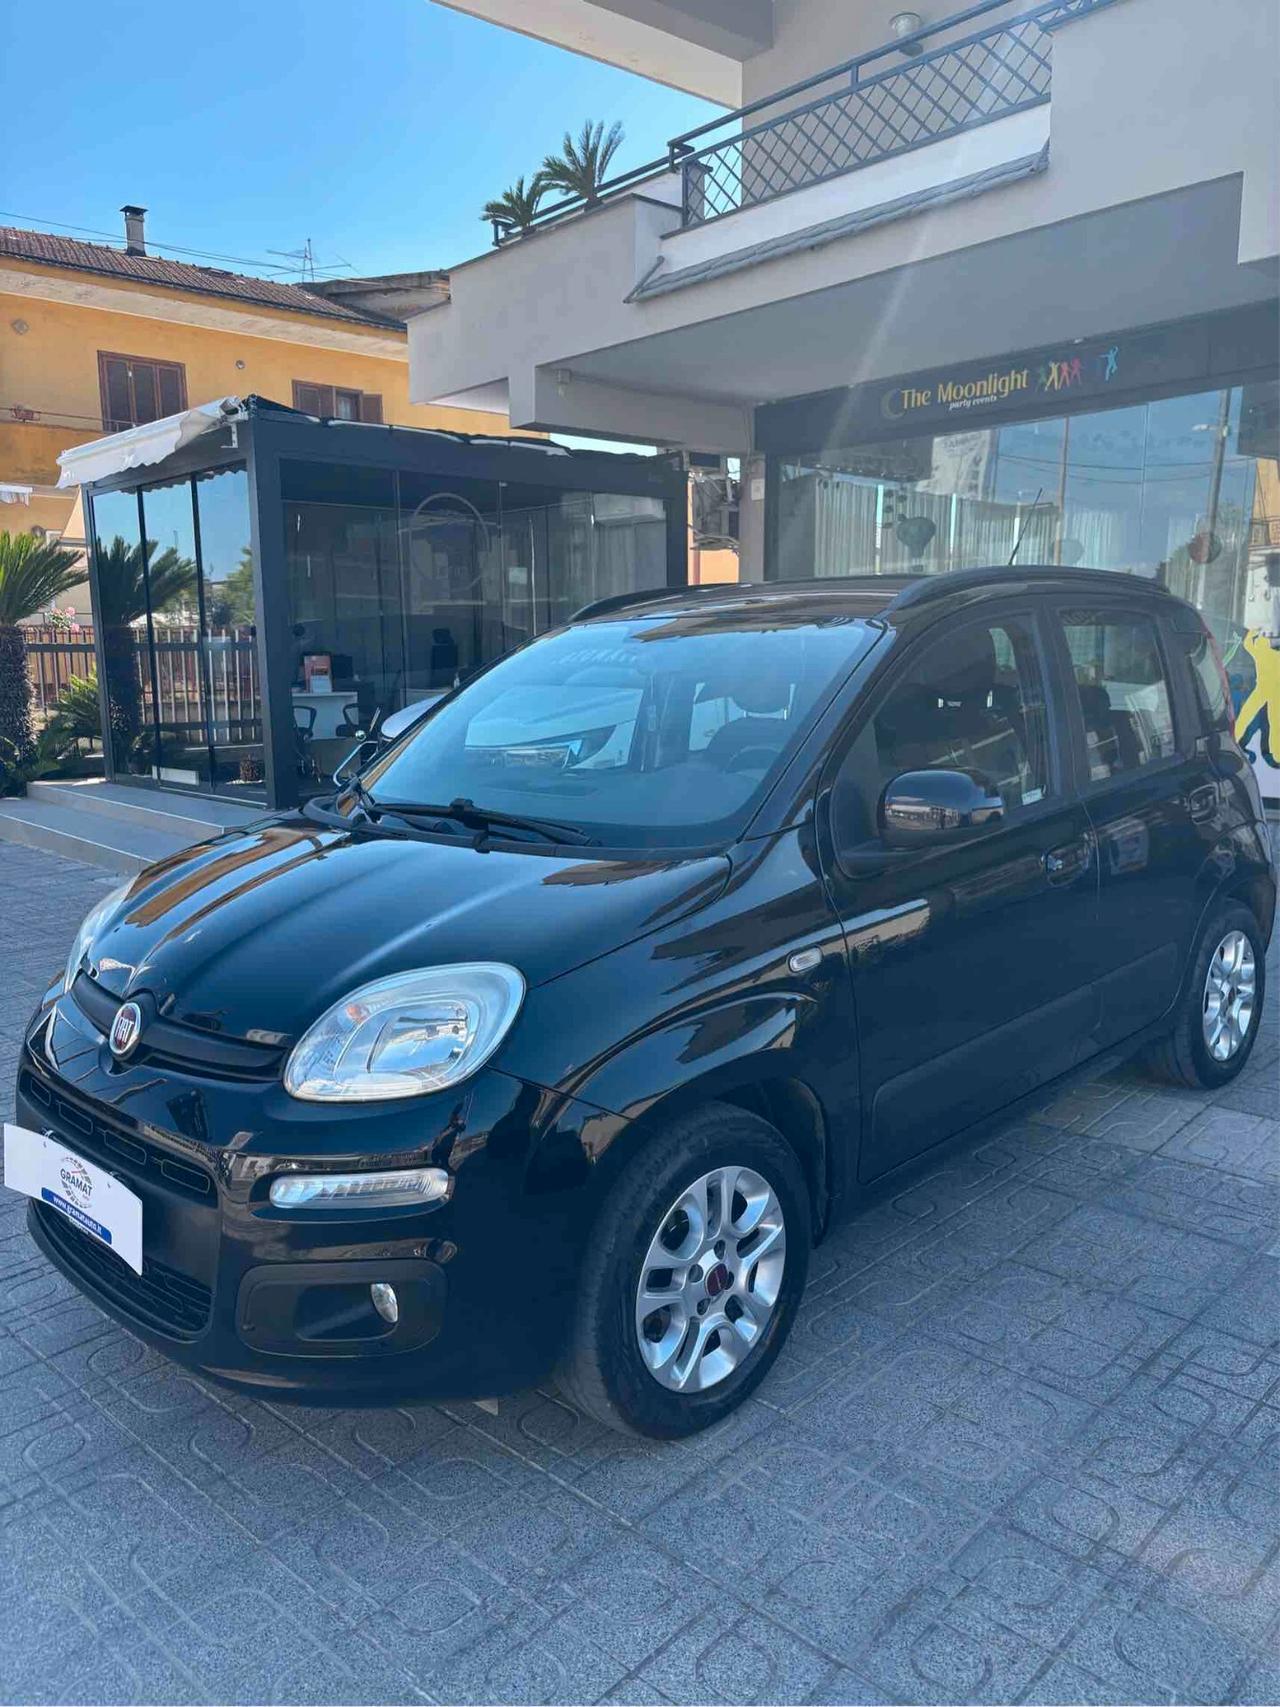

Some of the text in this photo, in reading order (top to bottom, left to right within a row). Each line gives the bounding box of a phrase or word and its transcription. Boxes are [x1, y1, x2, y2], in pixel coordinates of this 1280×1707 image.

[901, 368, 1029, 409] The Moonlight
[949, 394, 998, 410] party events
[114, 1016, 135, 1043] FIAT
[60, 1168, 93, 1197] GRAMAT
[53, 1195, 102, 1235] www.gramatauto.it
